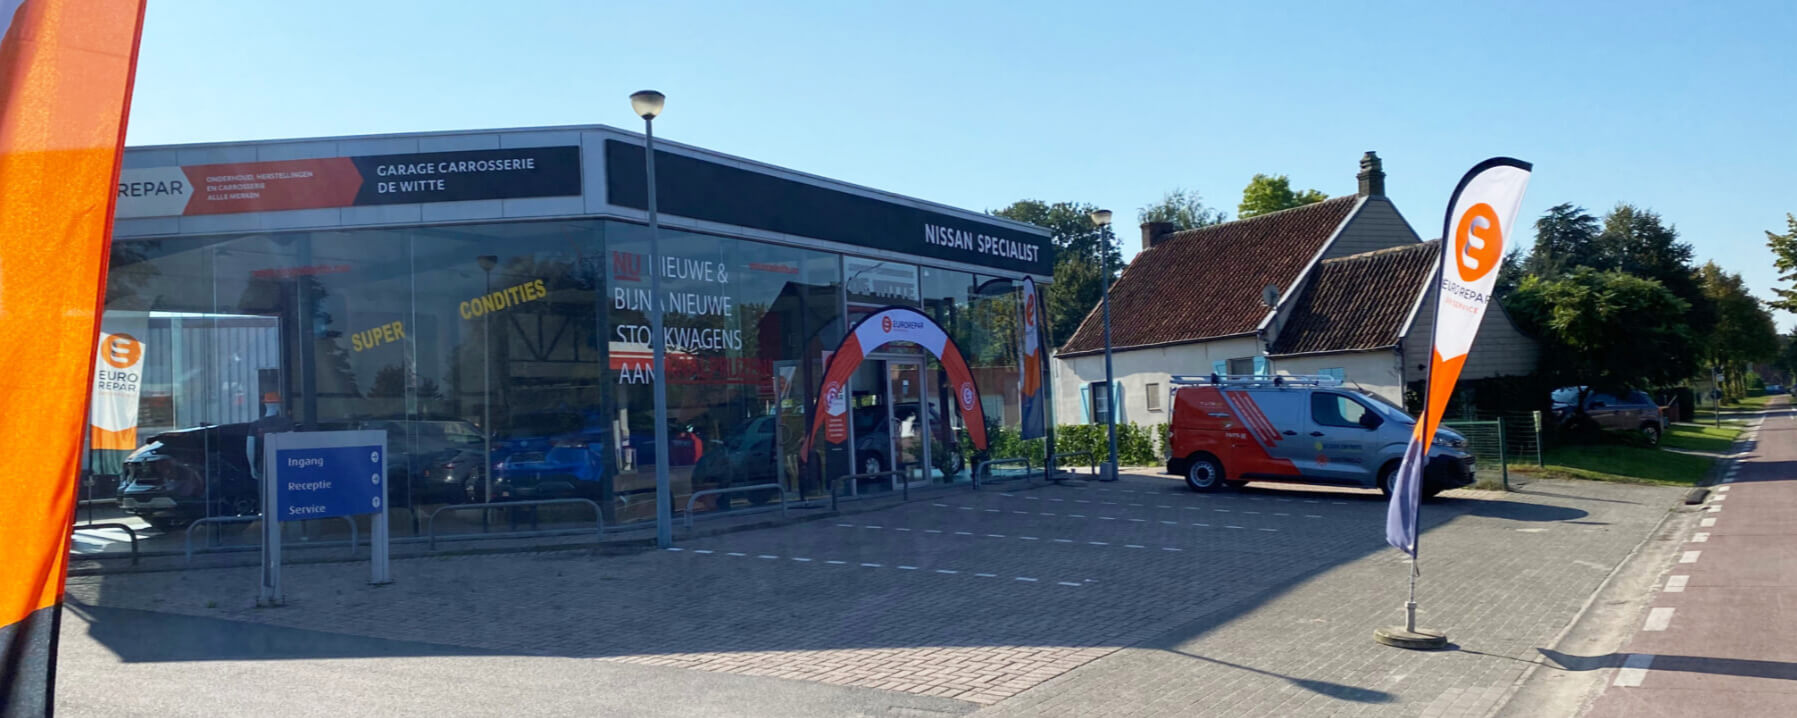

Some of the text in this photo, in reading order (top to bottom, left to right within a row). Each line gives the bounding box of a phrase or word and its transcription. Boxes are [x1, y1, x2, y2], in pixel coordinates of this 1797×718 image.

[377, 158, 535, 177] GARAGE CARROSSERIE
[206, 184, 217, 193] EN
[377, 179, 446, 194] DE WITTE
[924, 223, 1040, 262] NISSAN SPECIALIST
[612, 250, 642, 276] NU
[717, 263, 729, 284] &
[459, 279, 547, 320] CONDITIES
[669, 291, 732, 317] NIEUWE
[351, 321, 406, 352] SUPER
[616, 324, 743, 350] STOKWAGENS
[98, 370, 139, 383] EURO
[98, 380, 137, 392] REPAR
[287, 457, 324, 468] Ingang
[288, 480, 332, 492] Receptie
[288, 504, 326, 515] Service
